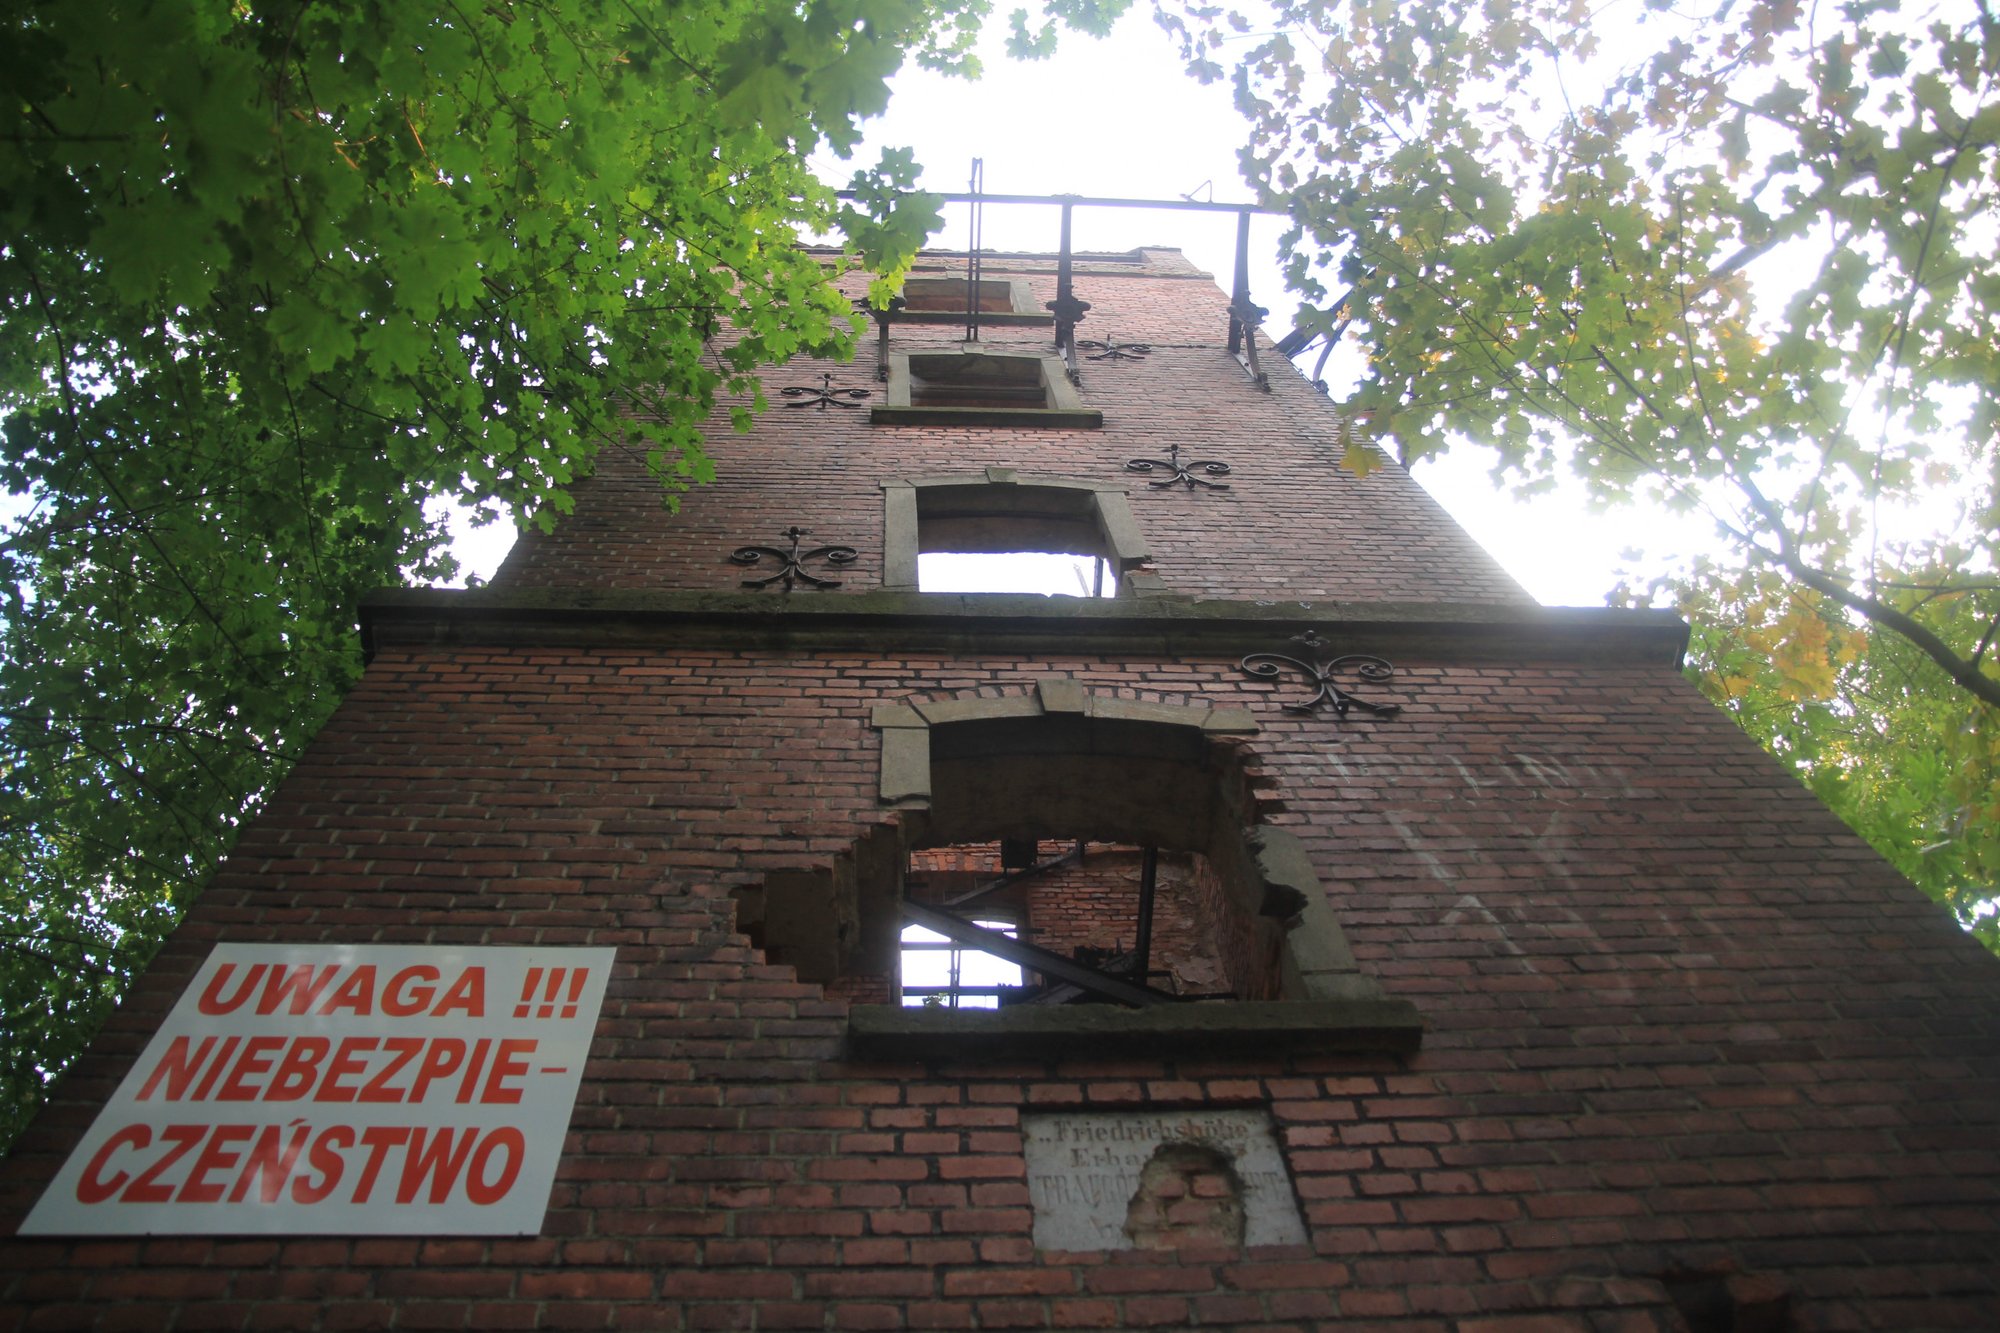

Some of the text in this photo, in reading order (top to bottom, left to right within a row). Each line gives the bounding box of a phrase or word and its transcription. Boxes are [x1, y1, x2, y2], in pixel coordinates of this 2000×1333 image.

[198, 963, 590, 1019] UWAGA !!!
[76, 1118, 526, 1206] CZEŃSTWO
